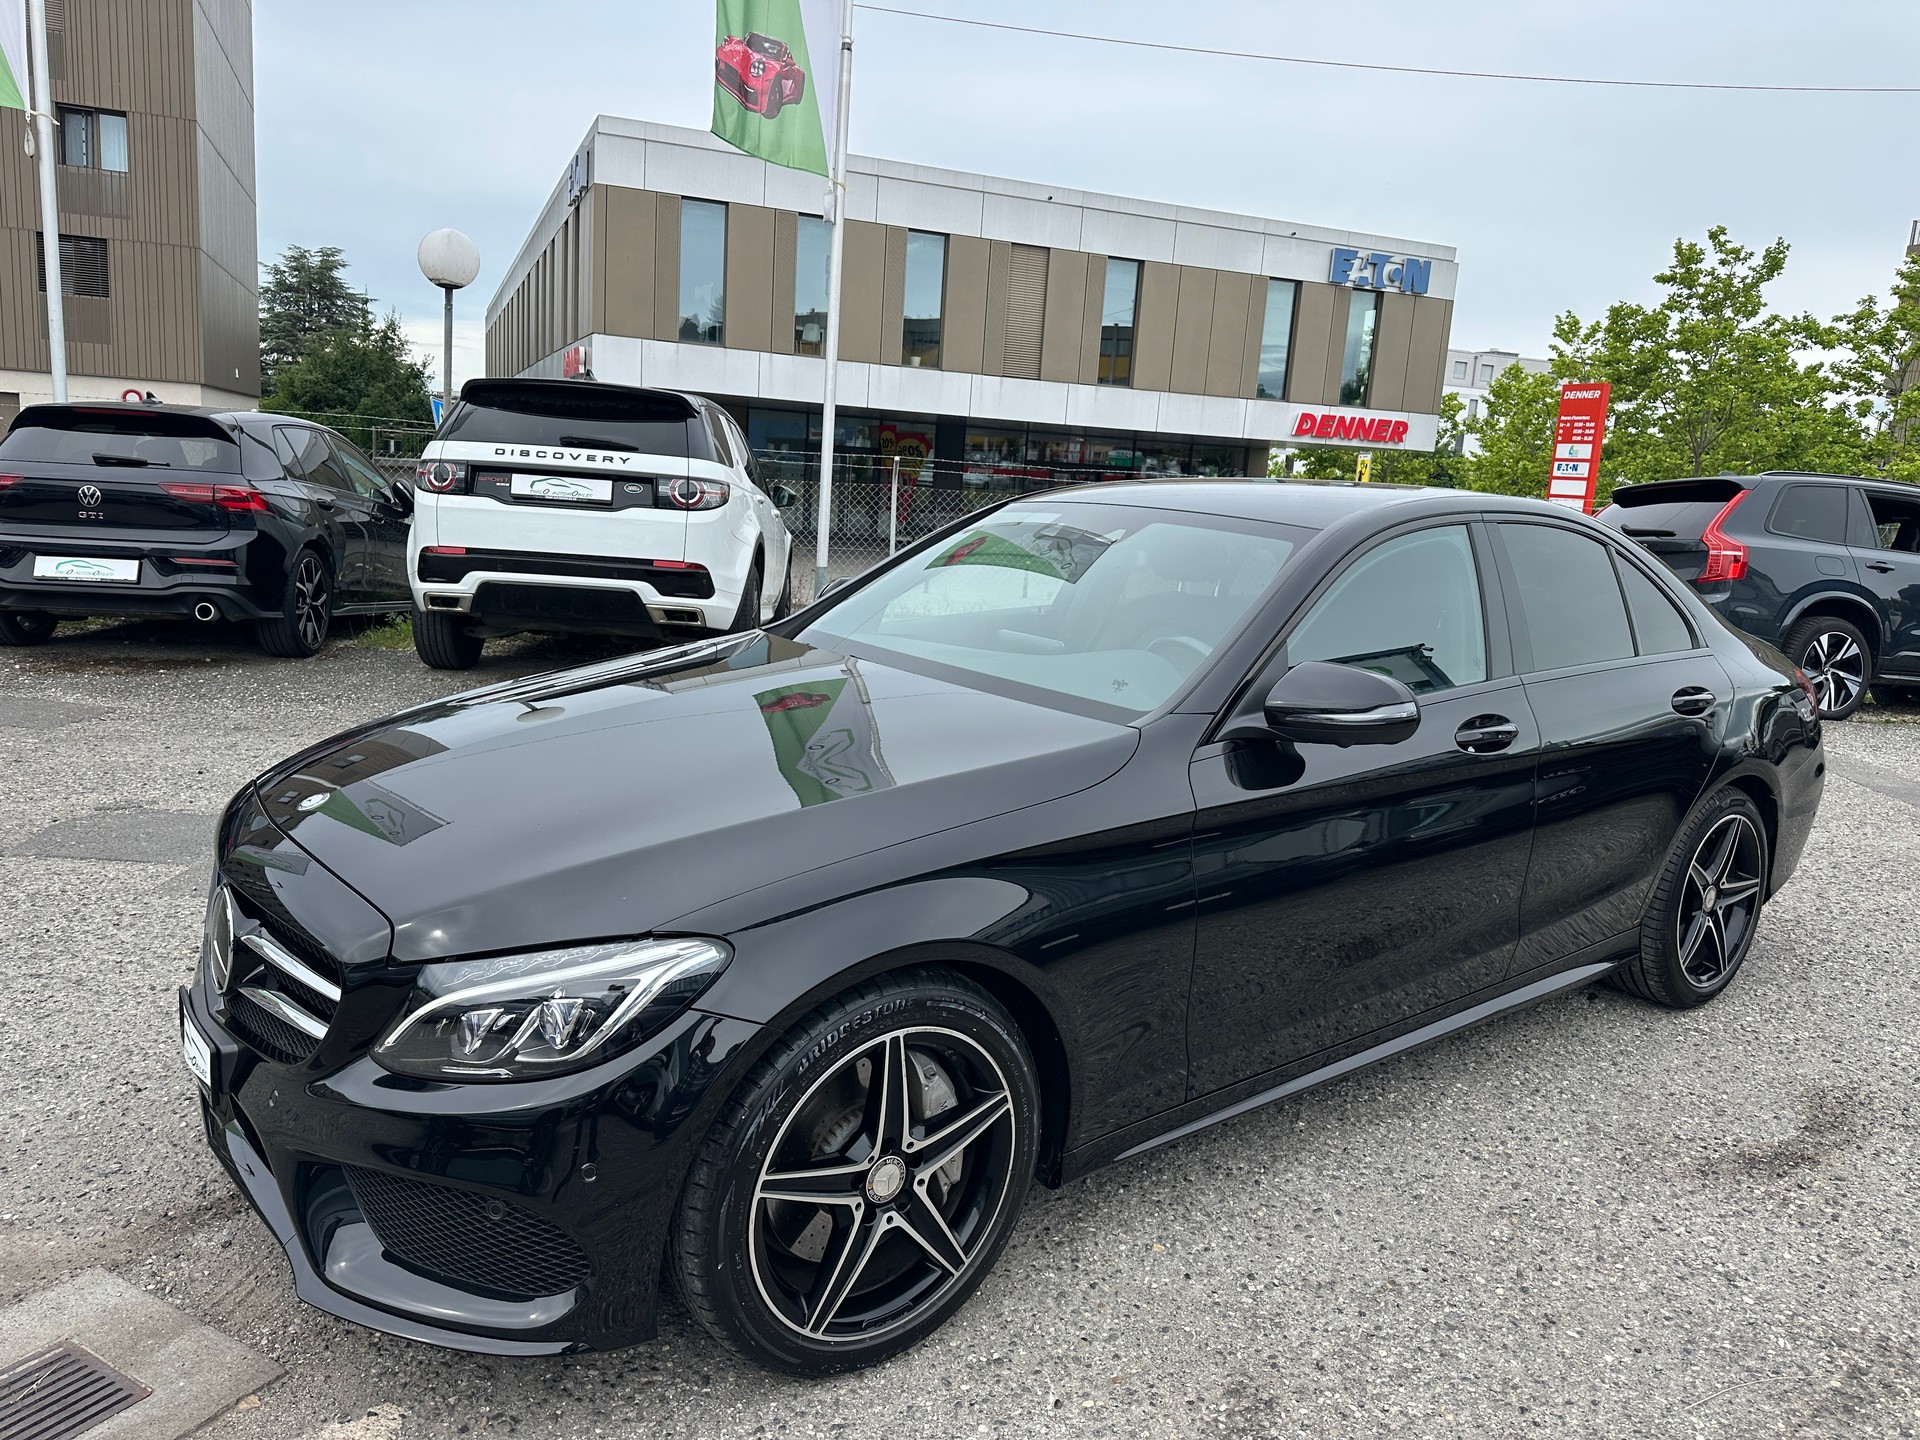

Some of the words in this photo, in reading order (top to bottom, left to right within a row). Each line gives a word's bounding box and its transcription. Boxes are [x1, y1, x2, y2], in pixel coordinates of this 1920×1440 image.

[1329, 247, 1432, 295] EATON
[1563, 390, 1601, 399] DENNER
[1292, 412, 1409, 443] DENNER
[494, 448, 631, 464] DISCOVERY
[1557, 463, 1579, 472] EATON
[78, 511, 104, 519] GTI
[797, 996, 916, 1076] BRIDGESTONE
